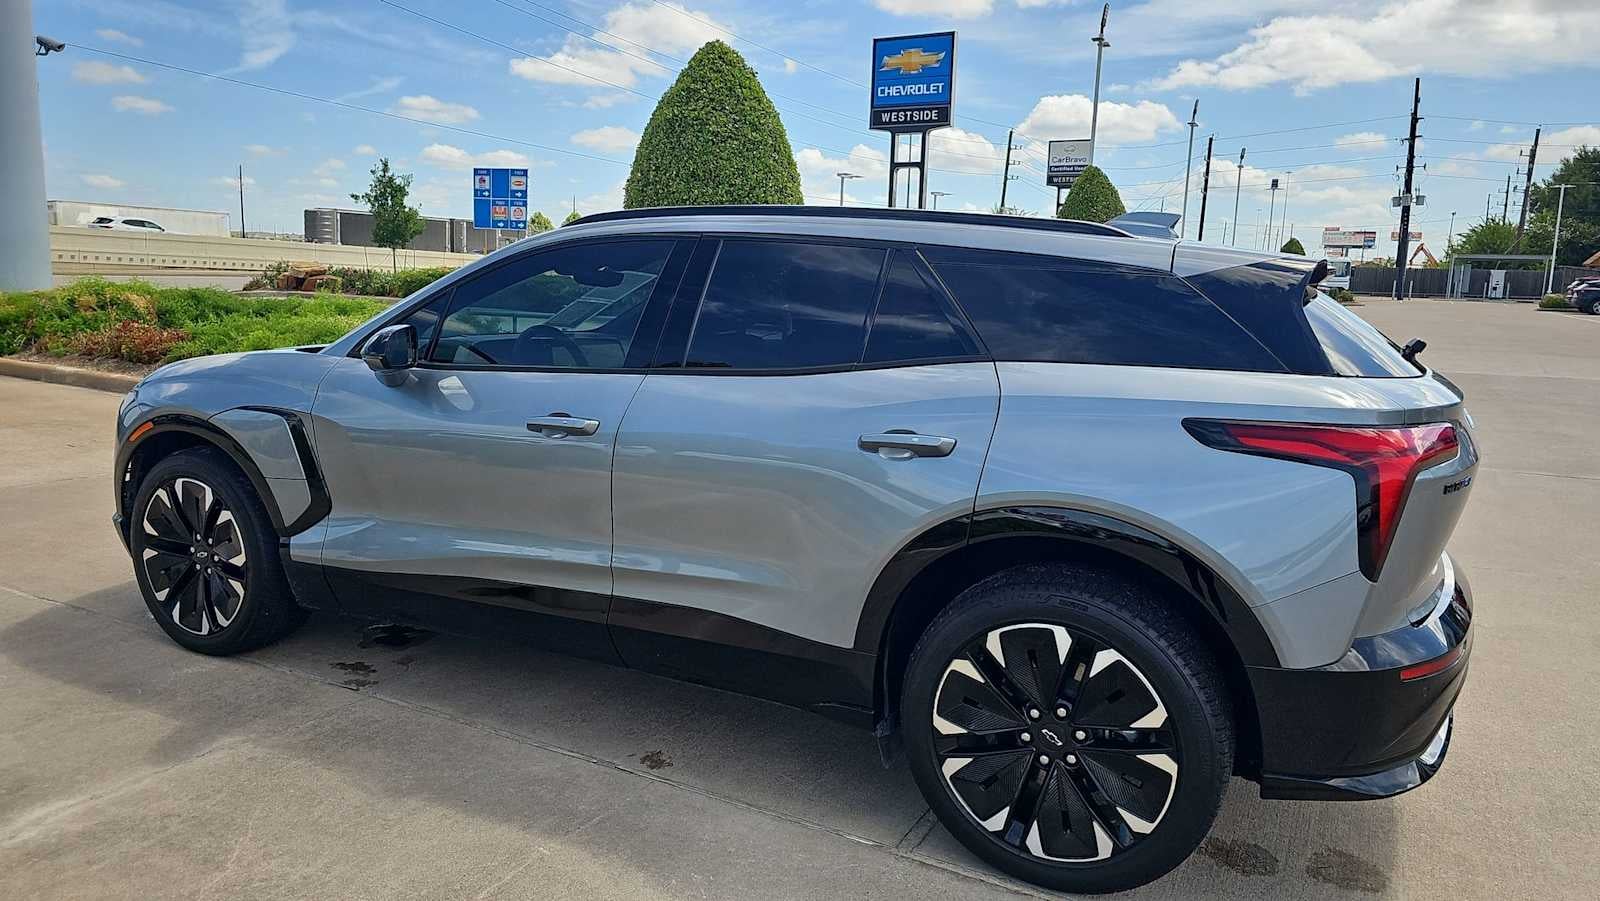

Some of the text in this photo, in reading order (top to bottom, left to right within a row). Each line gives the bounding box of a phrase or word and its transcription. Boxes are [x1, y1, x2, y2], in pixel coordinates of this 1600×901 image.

[877, 82, 945, 97] CHEVROLET
[881, 109, 939, 123] WESTSIDE
[1051, 156, 1087, 164] CarBravo
